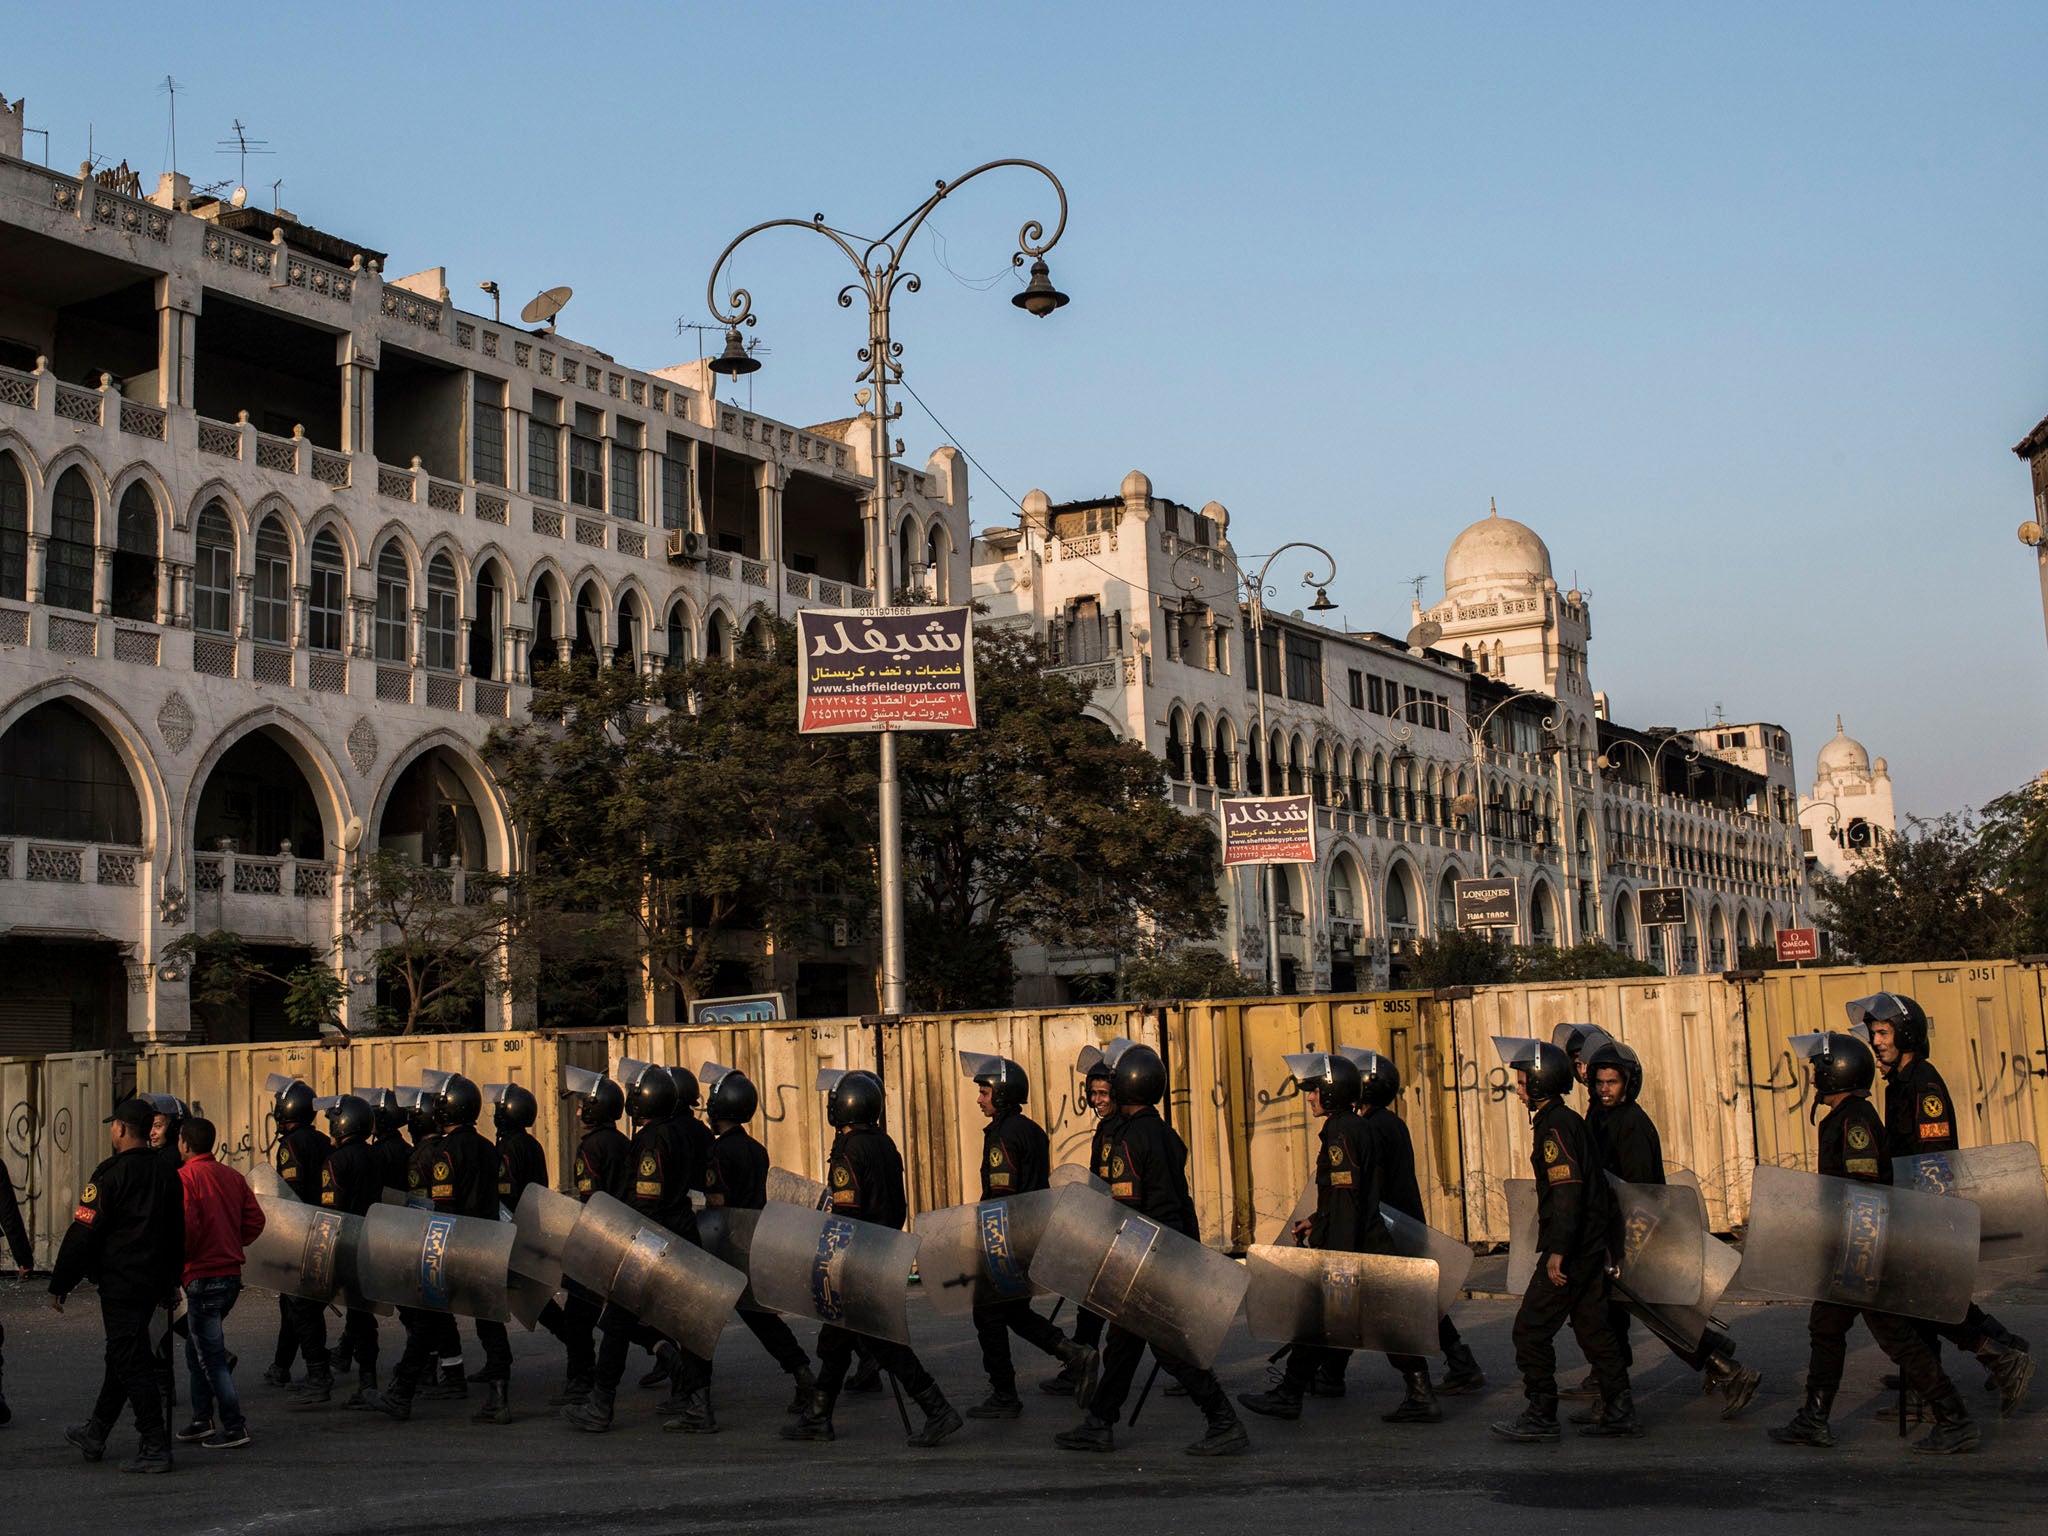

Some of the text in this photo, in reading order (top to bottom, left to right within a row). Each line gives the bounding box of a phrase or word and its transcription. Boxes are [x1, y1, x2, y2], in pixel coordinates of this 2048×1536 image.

[811, 662, 961, 681] فضيات تحف كريستال
[813, 682, 960, 693] www.sheffieldegypt.com
[871, 695, 907, 705] العقاد
[909, 694, 947, 707] عباس
[870, 708, 900, 721] دمشق
[902, 710, 917, 721] مع
[919, 708, 949, 719] بيروت
[1462, 888, 1510, 899] LONGINES
[1466, 912, 1484, 920] TIME
[1782, 940, 1810, 948] OMEGA
[1383, 1000, 1411, 1013] 9055
[1092, 1013, 1119, 1026] 9097
